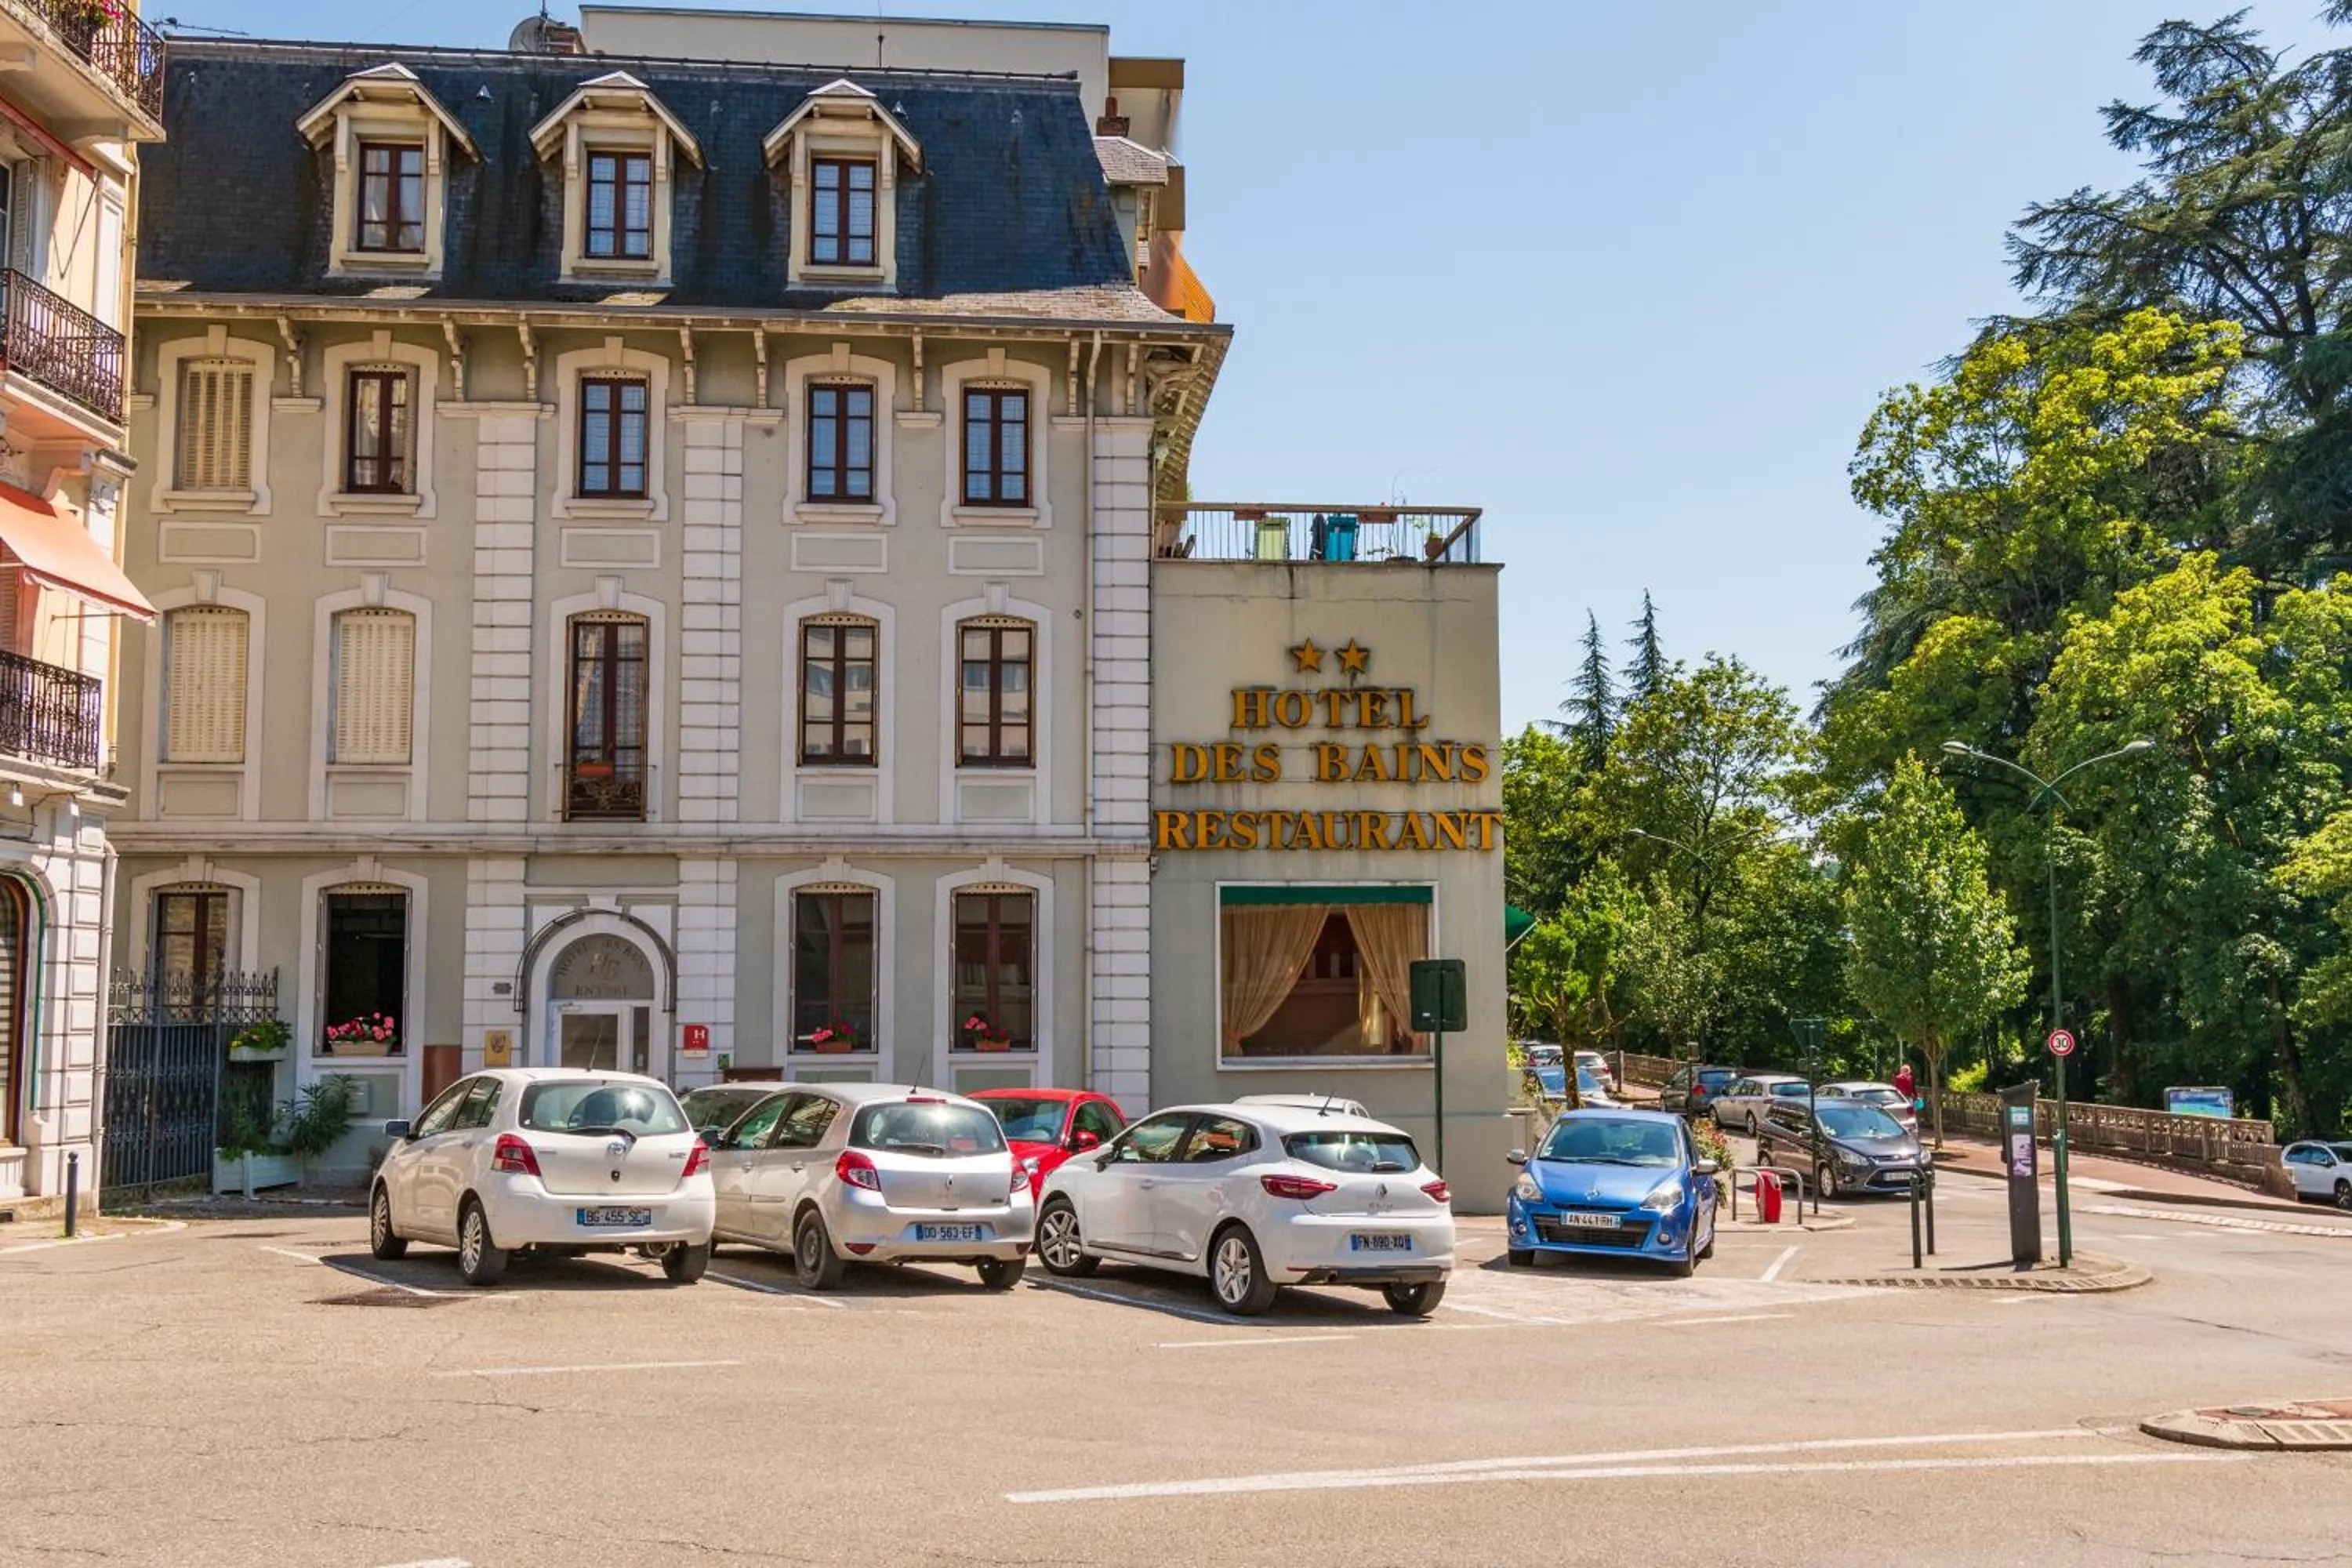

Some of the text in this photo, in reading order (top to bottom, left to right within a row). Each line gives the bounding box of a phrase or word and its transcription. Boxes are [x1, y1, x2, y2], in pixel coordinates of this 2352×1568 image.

[1231, 688, 1431, 729] HOTEL
[1171, 742, 1490, 783] DES BAINS
[1155, 810, 1503, 851] RESTAURANT
[2055, 1037, 2068, 1048] 30
